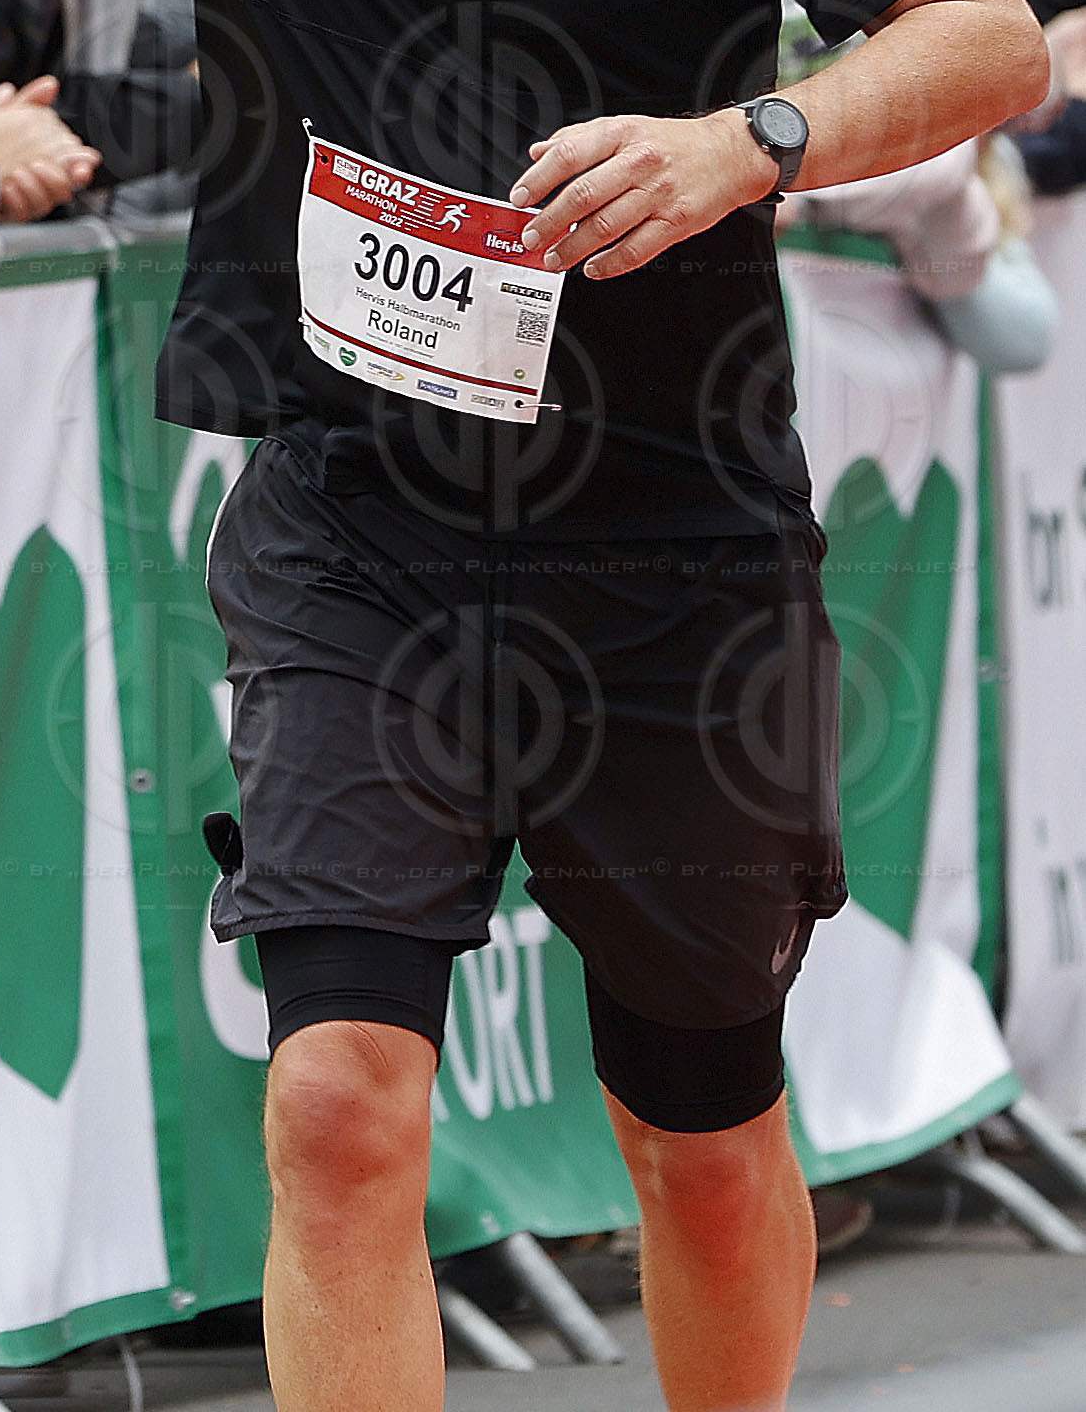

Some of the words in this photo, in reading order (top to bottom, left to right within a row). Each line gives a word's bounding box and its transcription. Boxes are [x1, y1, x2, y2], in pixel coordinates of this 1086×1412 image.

[345, 185, 398, 213] MARATHON
[360, 169, 420, 206] GRAZ
[378, 211, 404, 228] 2022
[485, 233, 524, 254] Hervis
[354, 232, 475, 313] 3004
[355, 286, 385, 306] Hervis
[387, 297, 461, 332] Halbmarathon
[368, 309, 439, 350] Roland
